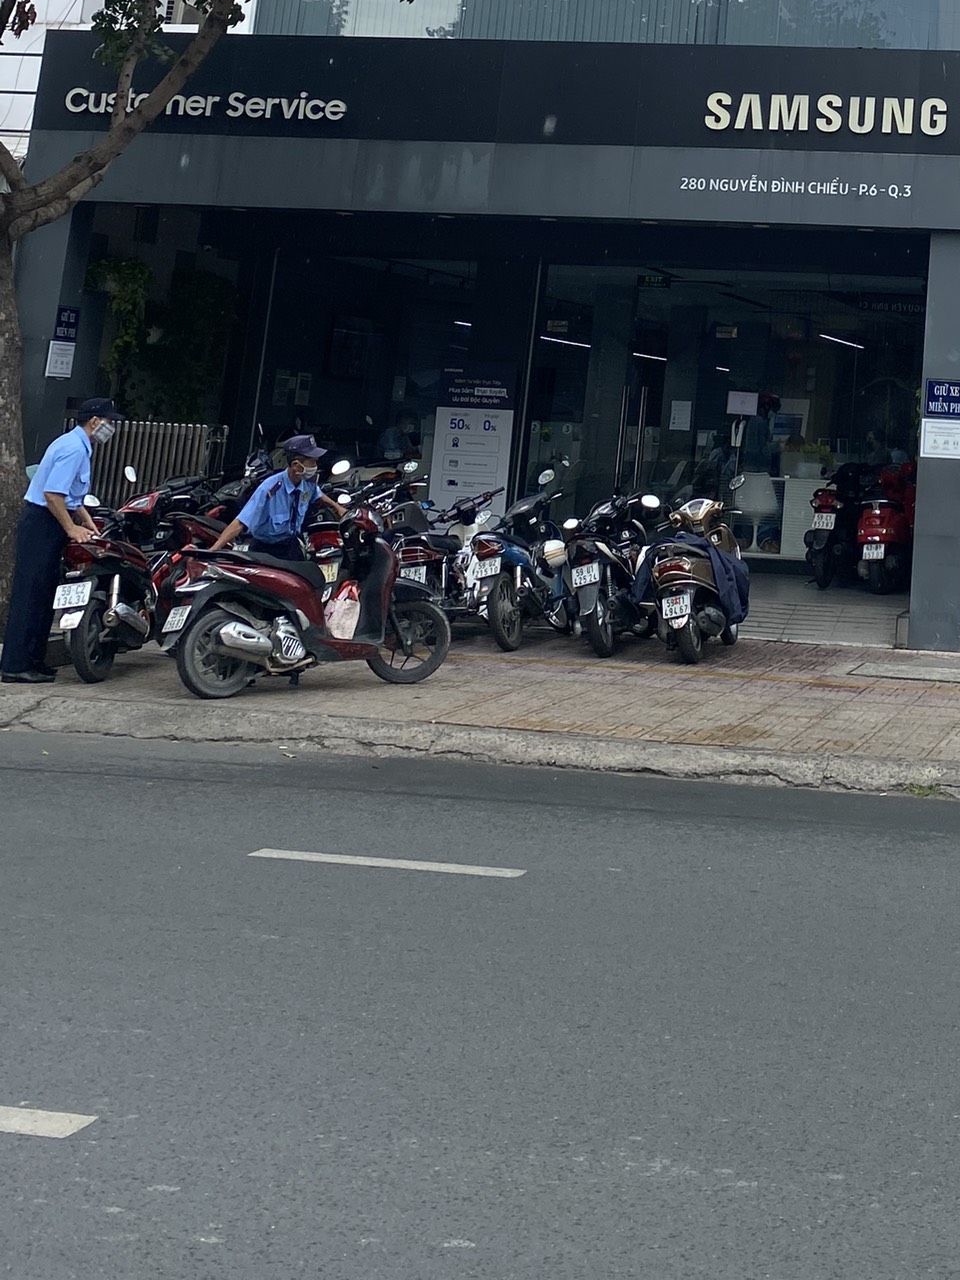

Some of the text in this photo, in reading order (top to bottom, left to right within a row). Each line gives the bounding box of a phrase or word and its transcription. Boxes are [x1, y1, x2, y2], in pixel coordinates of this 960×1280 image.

[226, 91, 348, 121] Service
[704, 92, 948, 136] SAMSUNG
[680, 177, 706, 191] 280
[709, 174, 767, 193] NGUYỄN
[771, 177, 805, 194] ĐÌNH
[808, 176, 849, 195] CHIỂU
[949, 386, 960, 397] XE
[450, 418, 496, 432] 50% 0%
